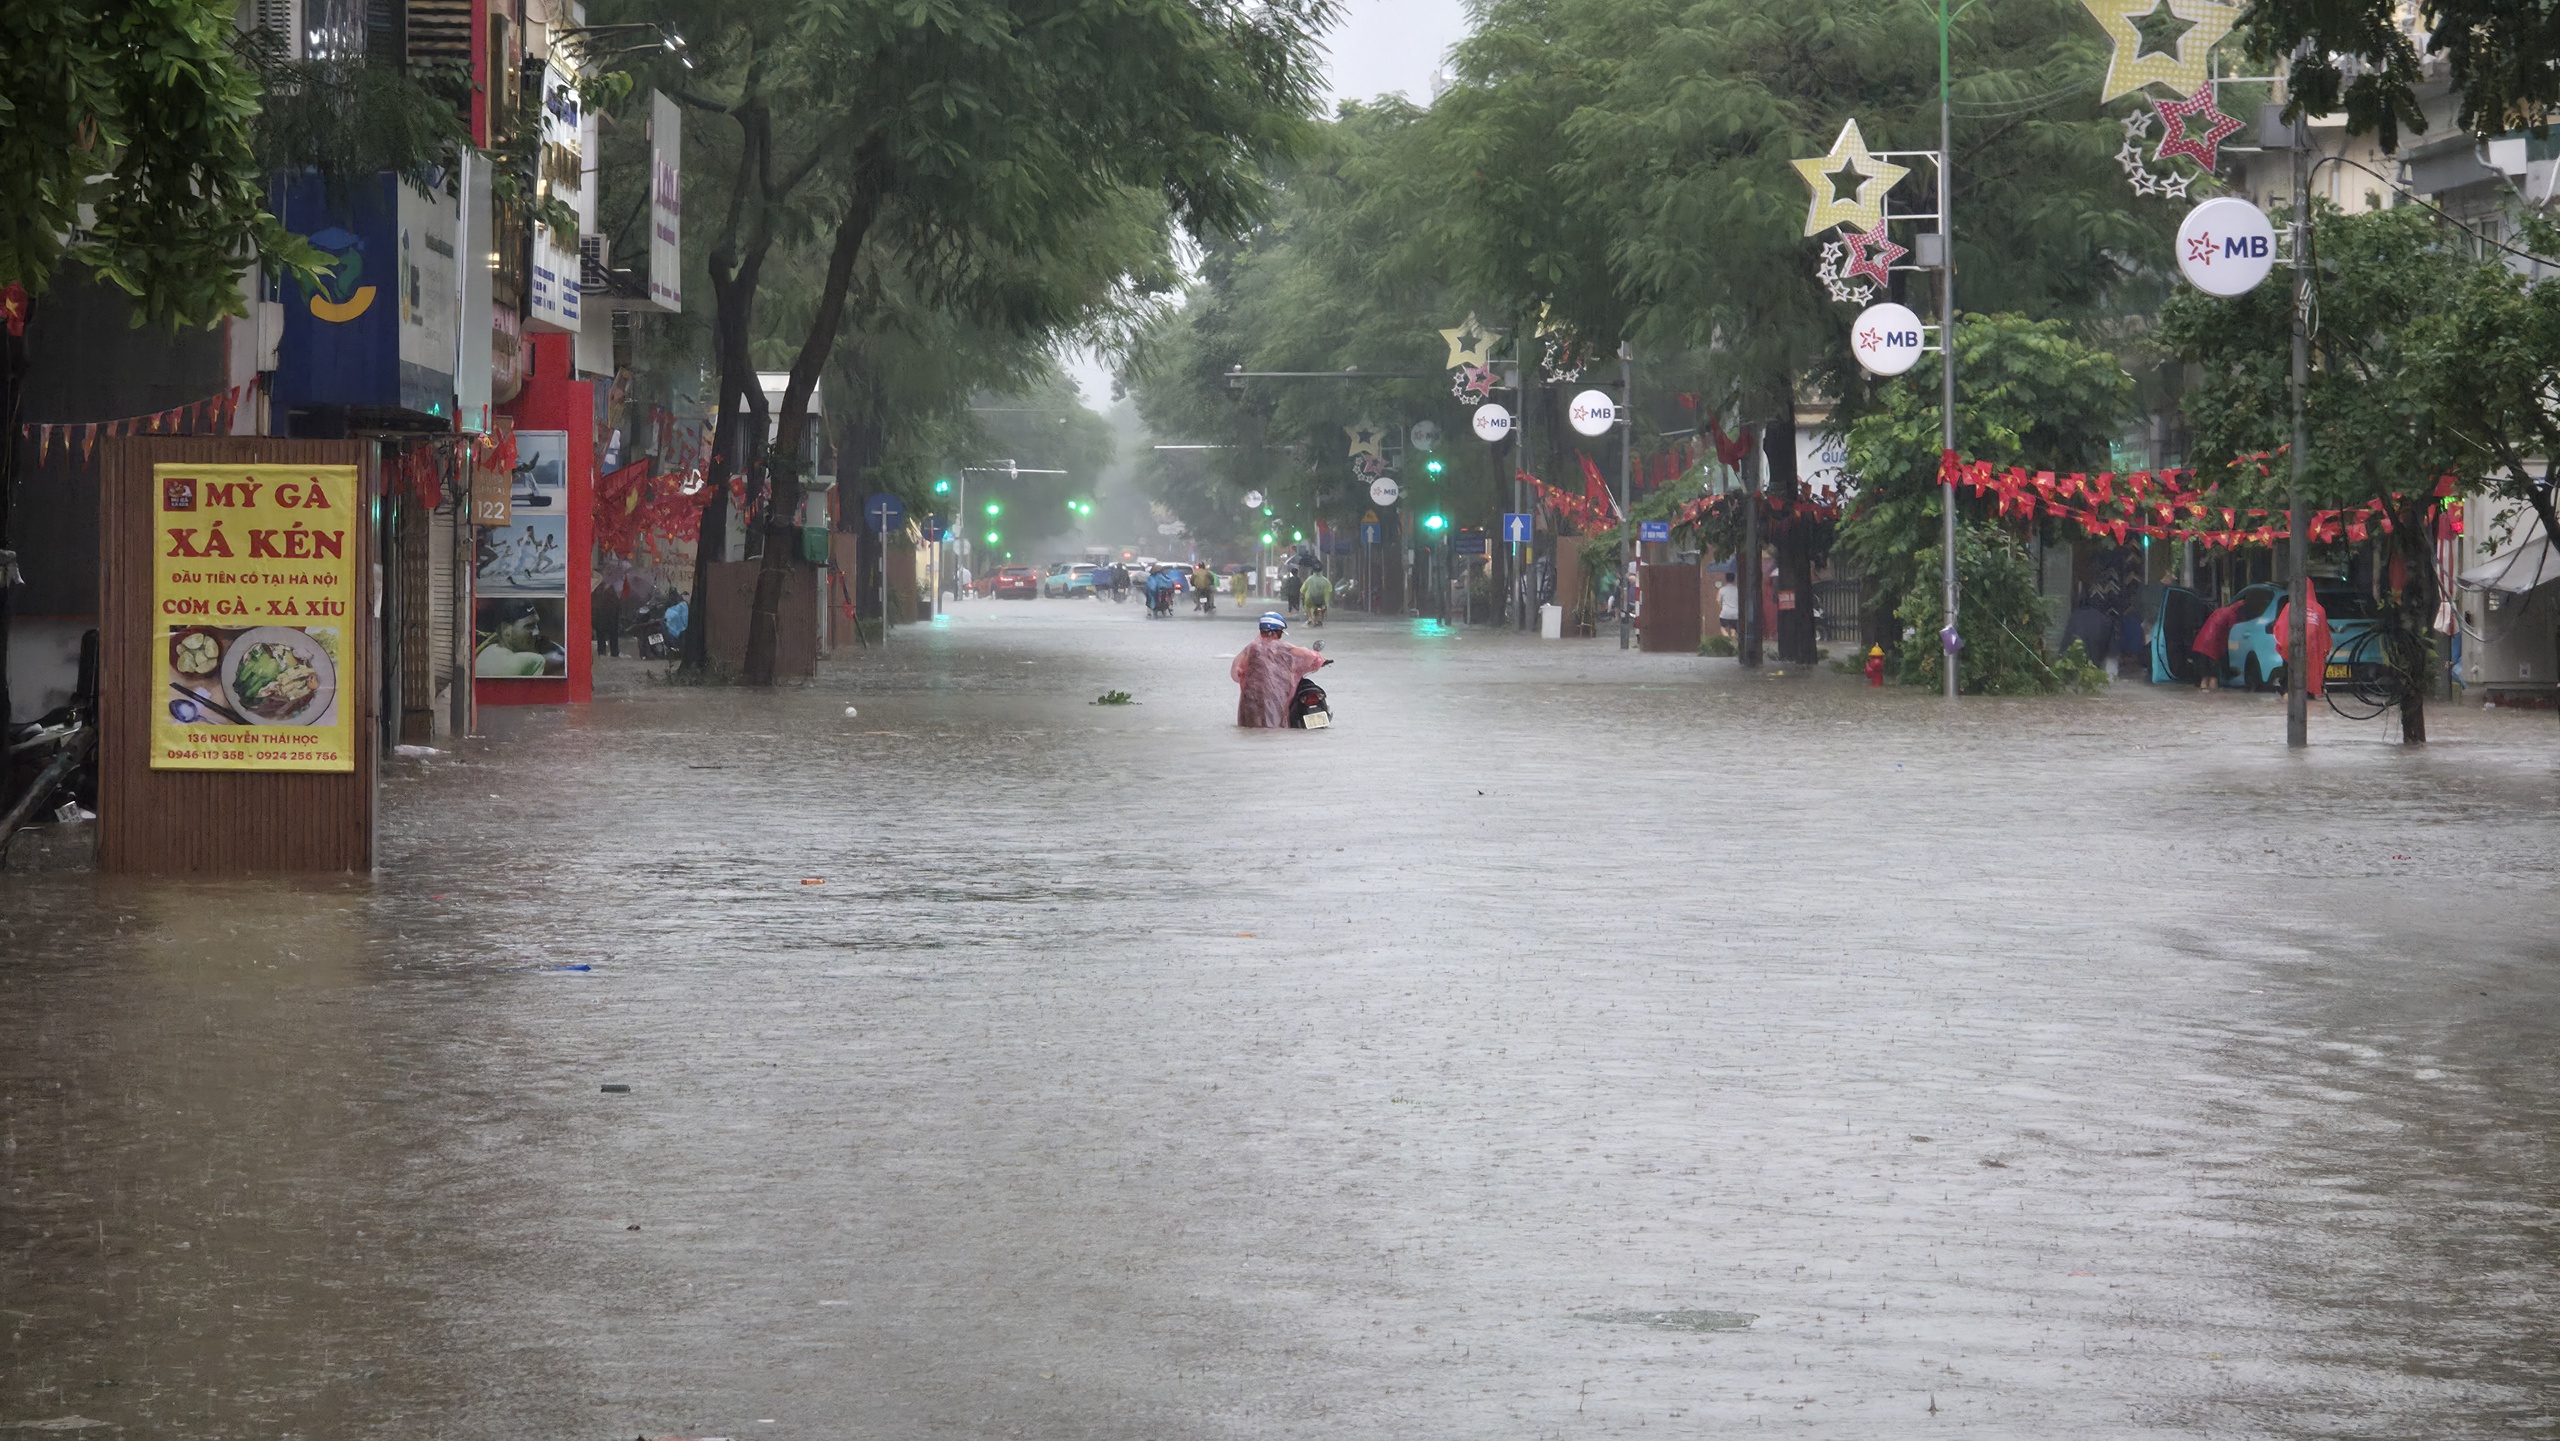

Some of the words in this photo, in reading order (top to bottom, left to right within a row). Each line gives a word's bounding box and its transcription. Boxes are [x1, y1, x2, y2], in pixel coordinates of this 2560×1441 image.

[2225, 236, 2269, 258] MB
[1886, 331, 1918, 347] MB
[1591, 408, 1611, 419] MB
[1490, 419, 1508, 428] MB
[205, 476, 263, 508] MỲ
[275, 476, 331, 509] GÀ
[1383, 488, 1397, 496] MB
[478, 501, 505, 519] 122
[167, 520, 234, 557] XÁ
[248, 521, 345, 559] KÉN
[172, 569, 201, 583] ĐẦU
[206, 571, 236, 583] TIÊN
[240, 571, 259, 584] CÓ
[262, 573, 285, 587] TẠI
[289, 571, 309, 585] HÀ
[313, 571, 338, 587] NỘI
[163, 597, 210, 615] CƠM
[216, 596, 249, 615] GÀ
[267, 596, 299, 616] XÁ
[305, 596, 346, 616] XÍU
[188, 734, 208, 743] 136
[211, 730, 259, 744] NGUYỄN
[262, 732, 290, 744] THÁI
[293, 735, 319, 746] HỌC
[167, 750, 199, 759] 0946
[256, 752, 287, 761] 0924
[291, 752, 313, 761] 256
[316, 752, 338, 761] 756
